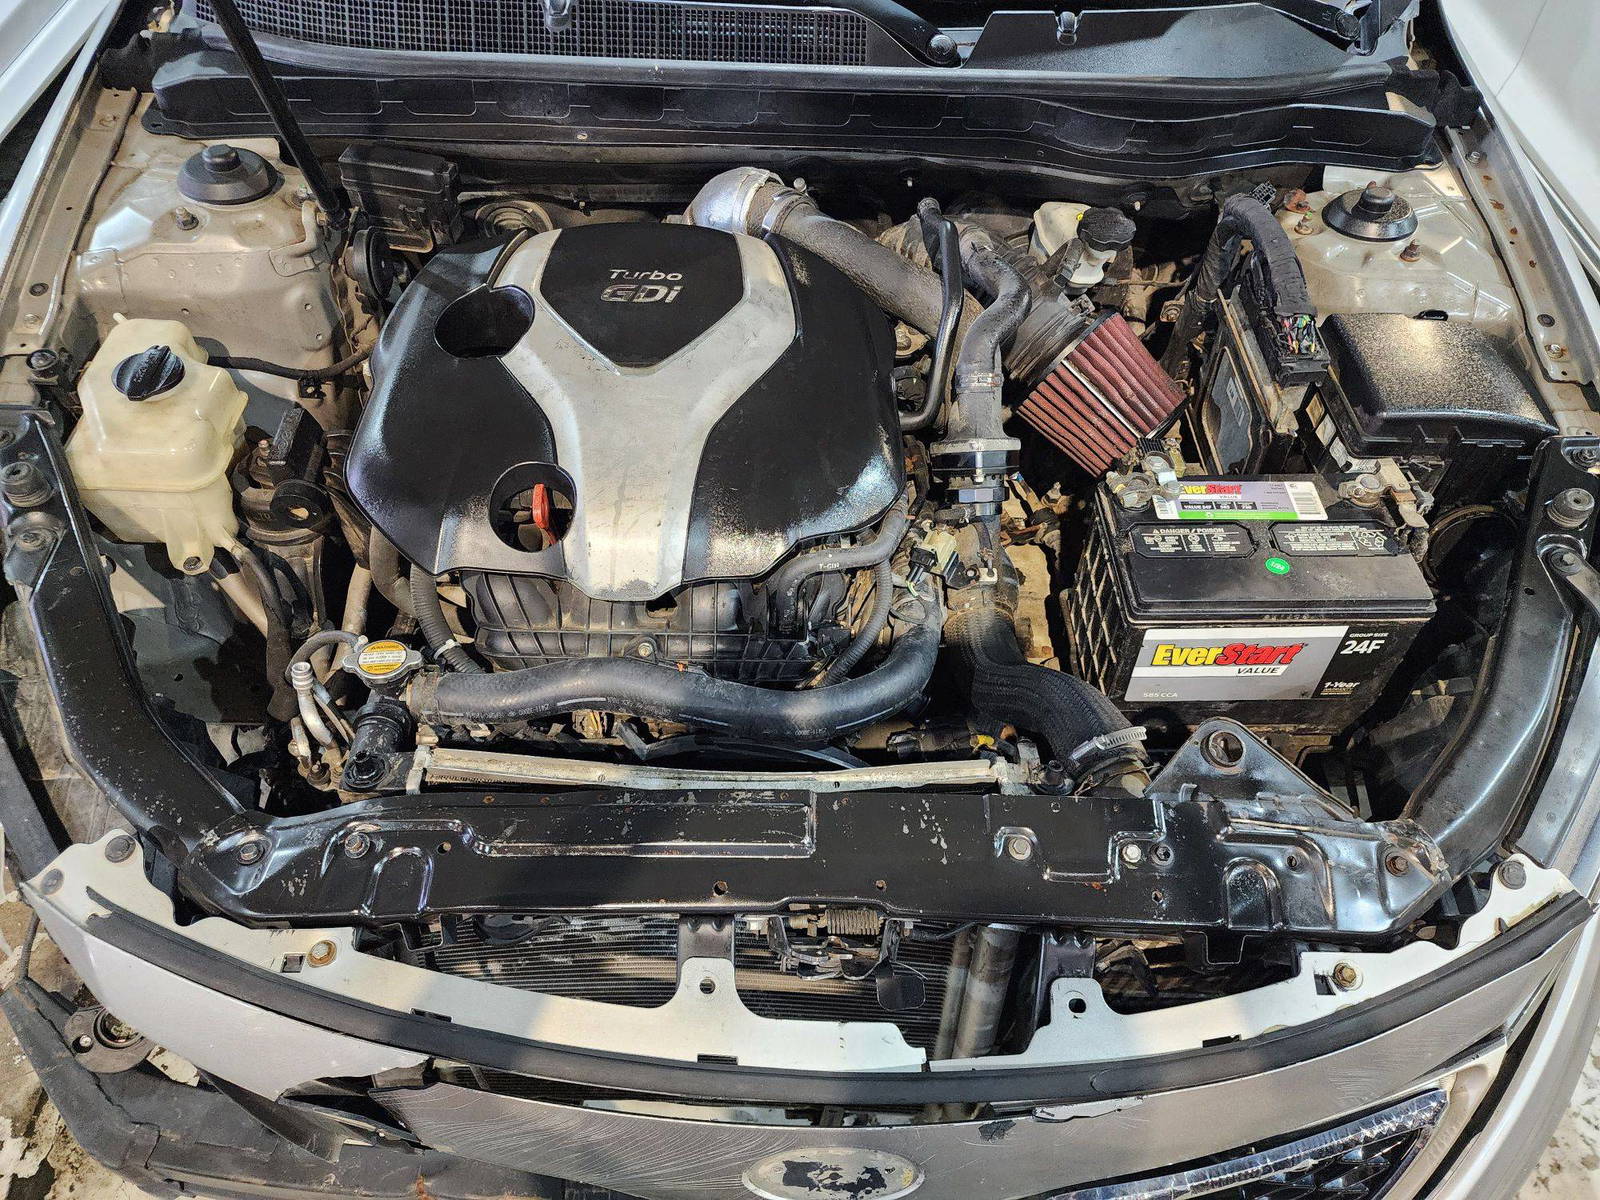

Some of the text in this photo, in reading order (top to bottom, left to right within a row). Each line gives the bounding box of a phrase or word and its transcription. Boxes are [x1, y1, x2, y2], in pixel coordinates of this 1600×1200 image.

[609, 269, 682, 281] Turbo
[600, 284, 683, 303] GDi
[1151, 642, 1305, 667] EverStart
[1340, 640, 1385, 655] 24F
[1237, 666, 1280, 675] VALUE
